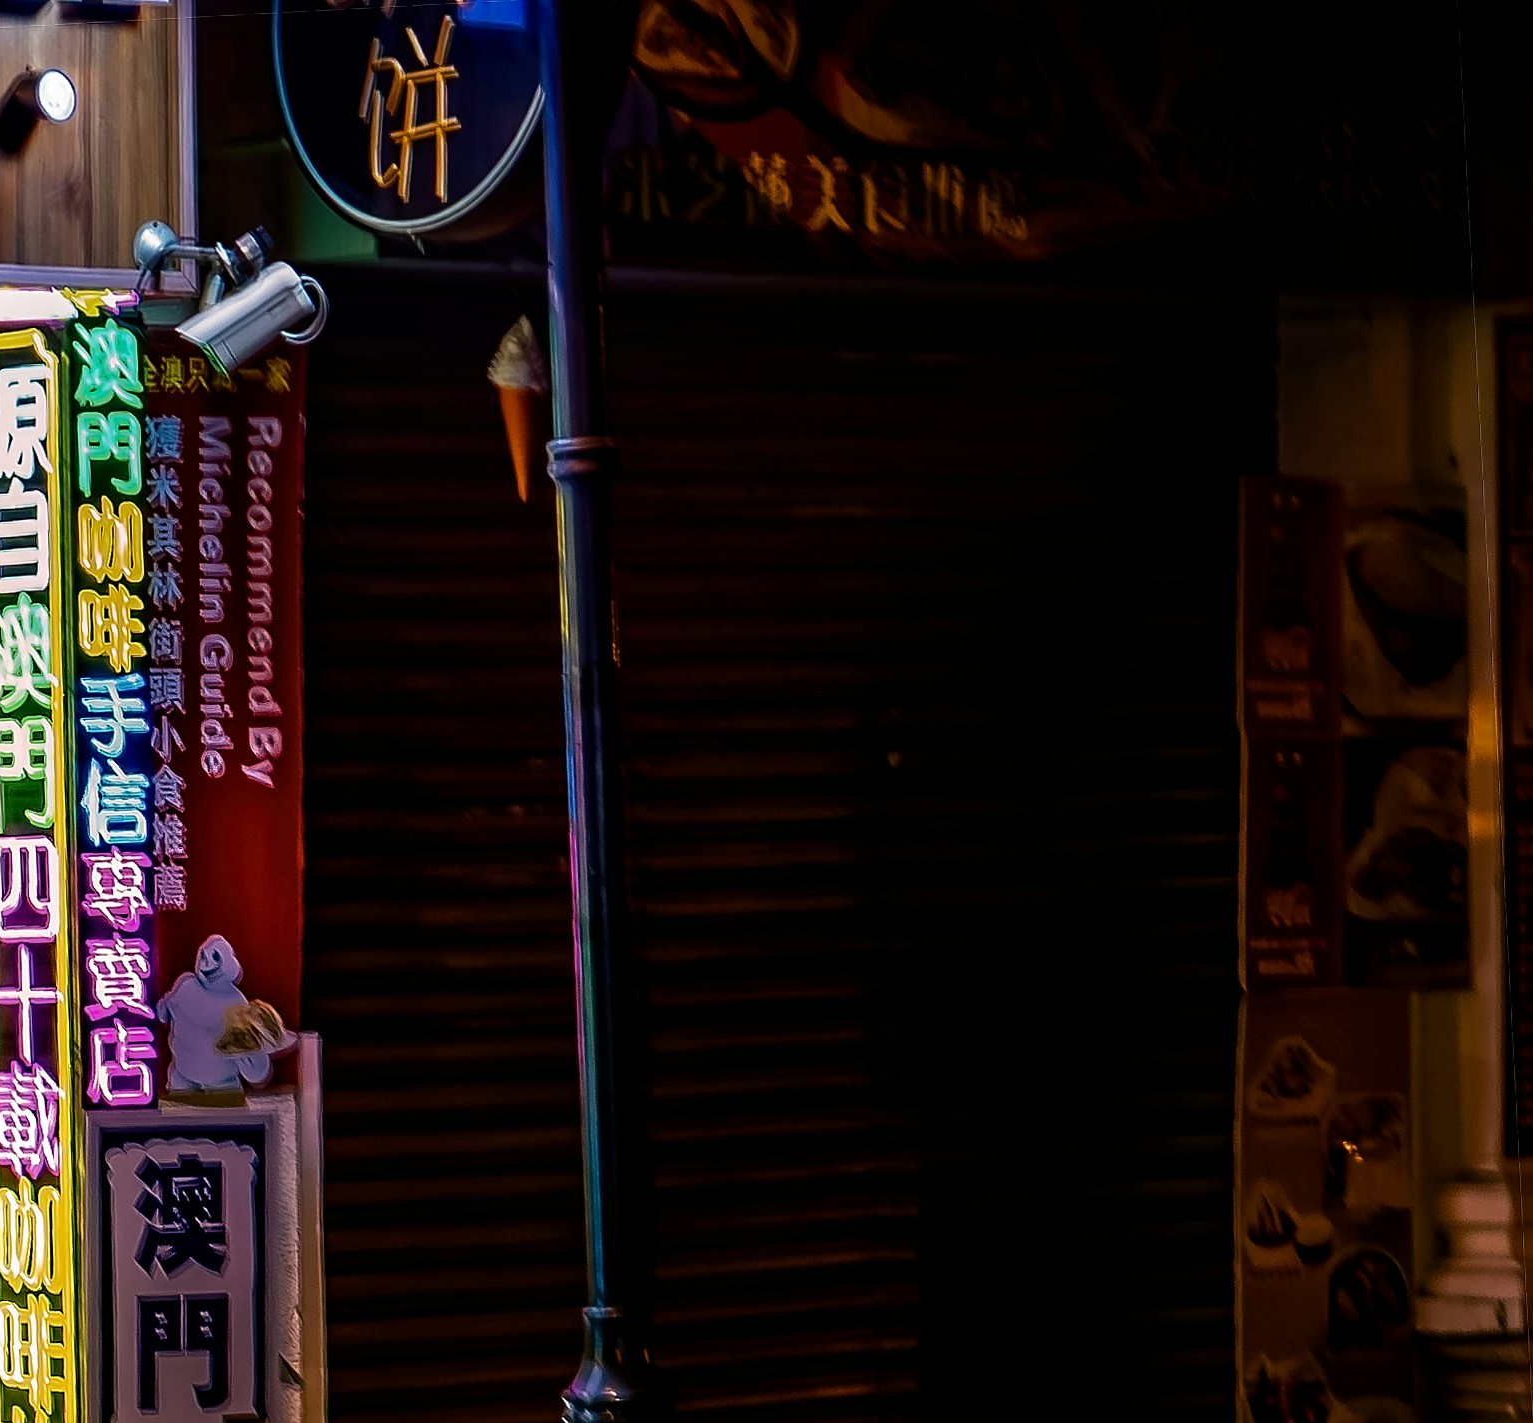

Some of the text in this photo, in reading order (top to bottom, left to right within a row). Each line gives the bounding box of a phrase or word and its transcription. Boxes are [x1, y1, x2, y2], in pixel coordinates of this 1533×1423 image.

[197, 415, 235, 780] Michelin Guide
[240, 415, 285, 790] Recommend By
[132, 1152, 230, 1416] 澳門
